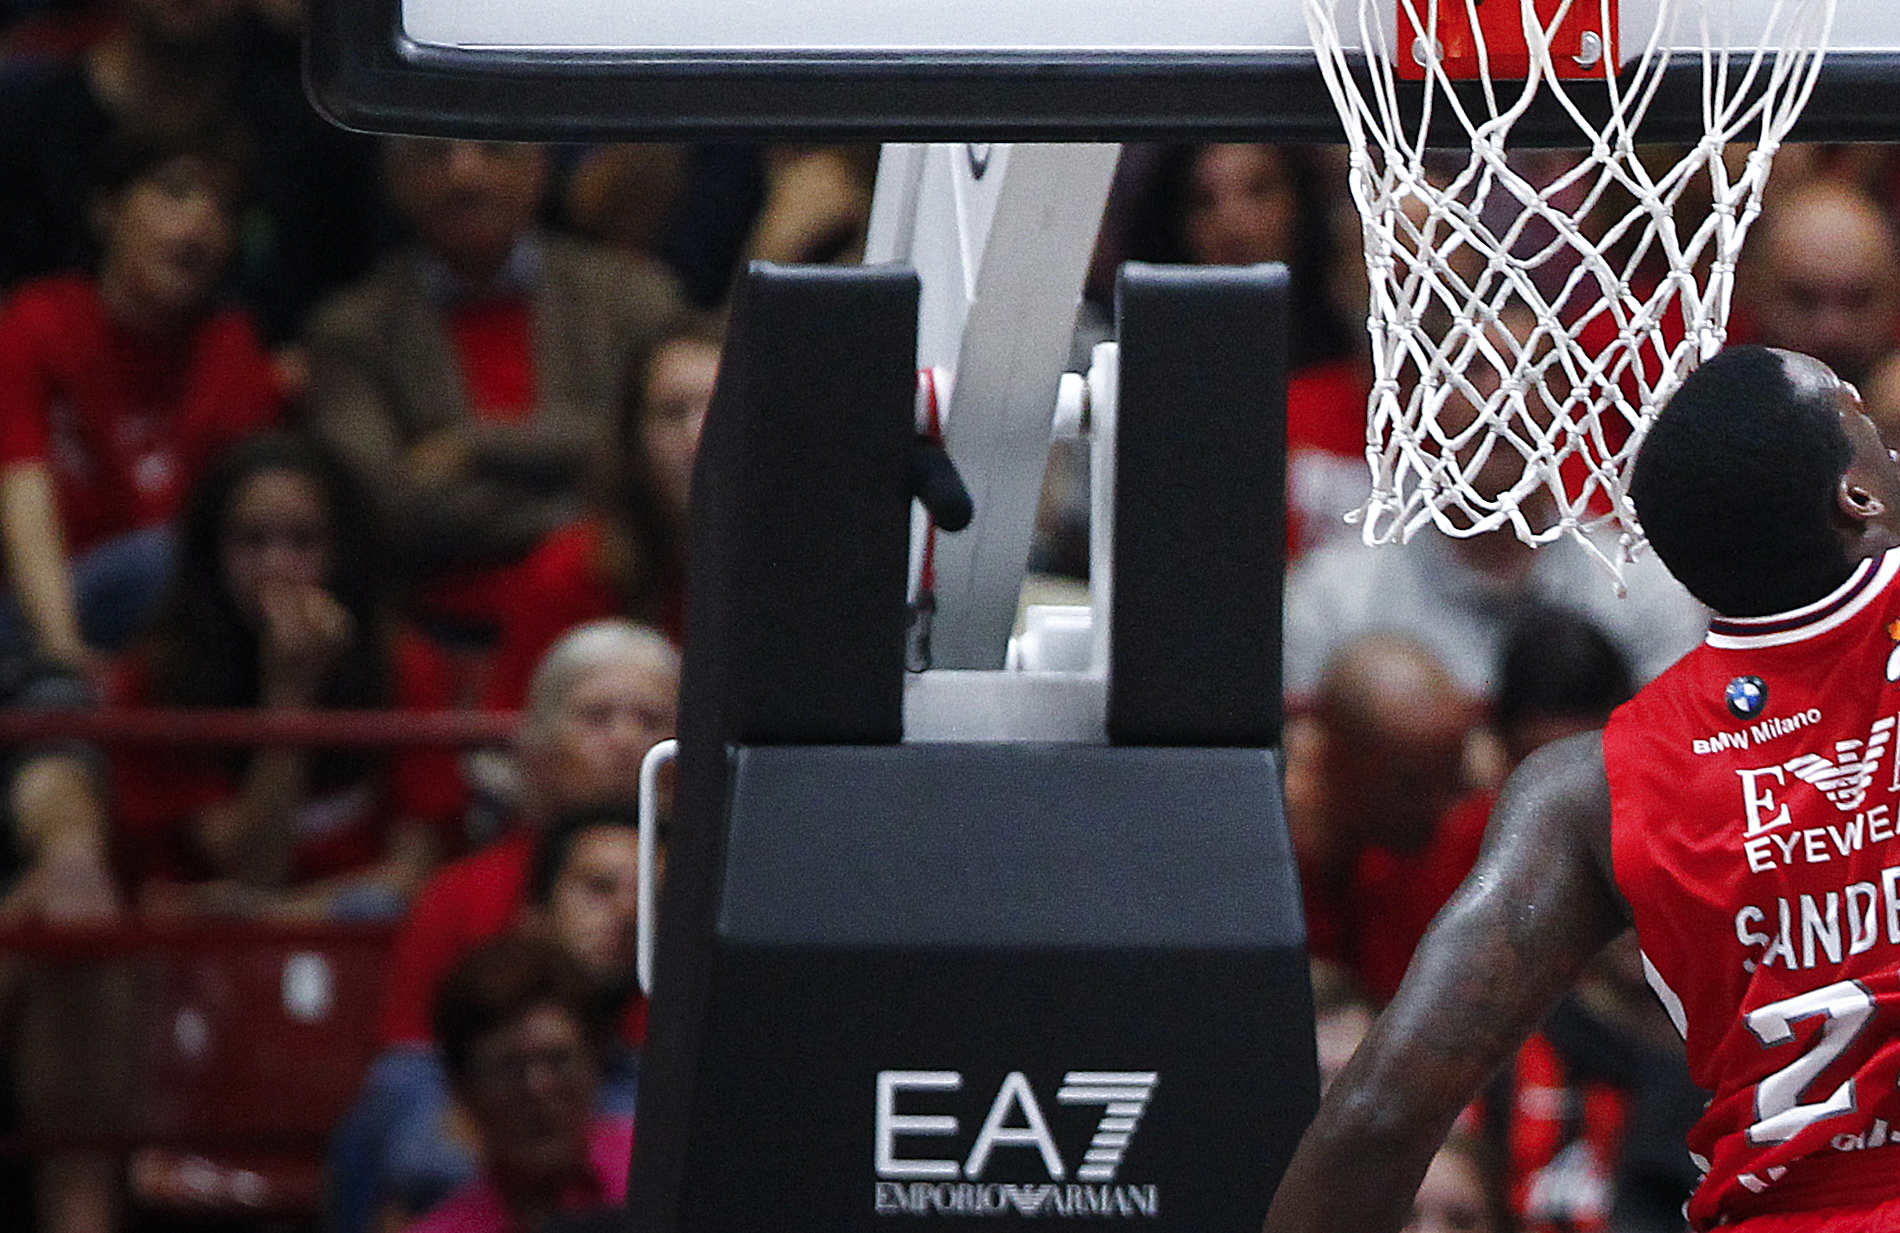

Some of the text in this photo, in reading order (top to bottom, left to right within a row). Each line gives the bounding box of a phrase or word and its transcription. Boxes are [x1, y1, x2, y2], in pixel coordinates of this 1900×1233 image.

[1692, 708, 1823, 756] BMW Milano
[874, 1070, 1159, 1181] EA7
